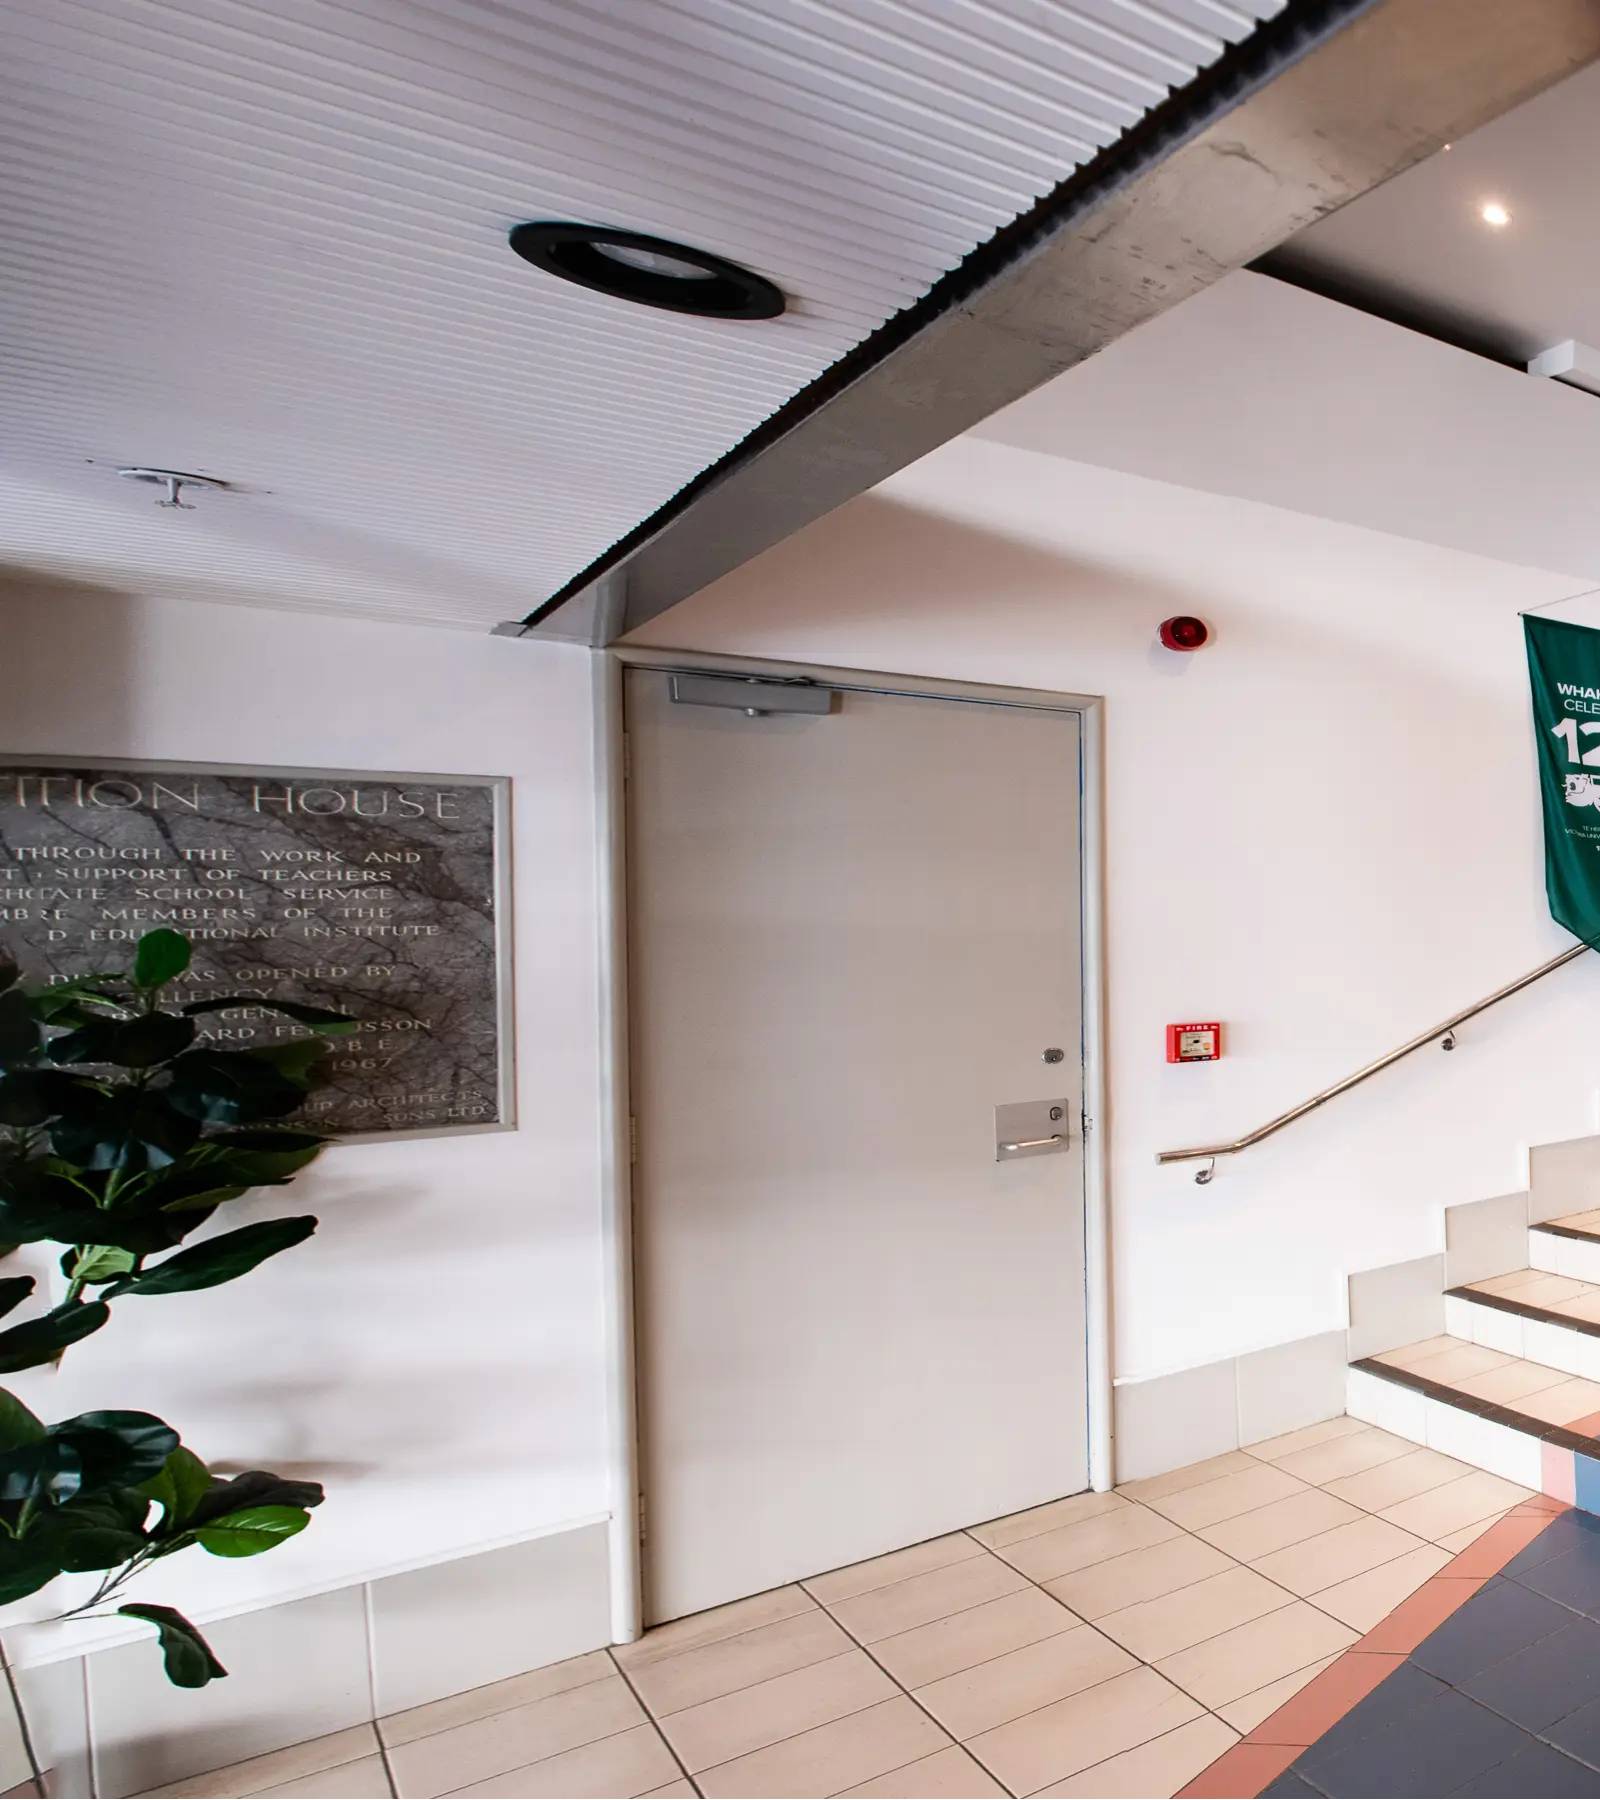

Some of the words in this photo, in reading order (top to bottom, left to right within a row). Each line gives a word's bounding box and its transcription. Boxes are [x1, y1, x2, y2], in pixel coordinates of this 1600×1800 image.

[253, 785, 460, 819] HOUSE
[16, 847, 161, 861] THROUGH
[184, 848, 237, 861] THE
[261, 850, 345, 863] WORK
[364, 851, 421, 864] AND
[55, 868, 188, 881] SUPPORT
[206, 868, 242, 881] OF
[258, 869, 392, 882] TEACHERS
[135, 888, 251, 901] SCHOOL
[282, 888, 393, 901] SERVICE
[102, 908, 256, 921] MEMBERS
[284, 907, 316, 919] OF
[344, 906, 393, 918] THE
[91, 927, 279, 941] EDUTIONAL
[304, 924, 439, 937] INSTITUTE
[236, 967, 348, 981] OPENED
[366, 965, 397, 978] BY
[332, 1057, 393, 1071] 1967
[349, 1089, 482, 1110] ARCHITECTS
[383, 1108, 437, 1124] SONS
